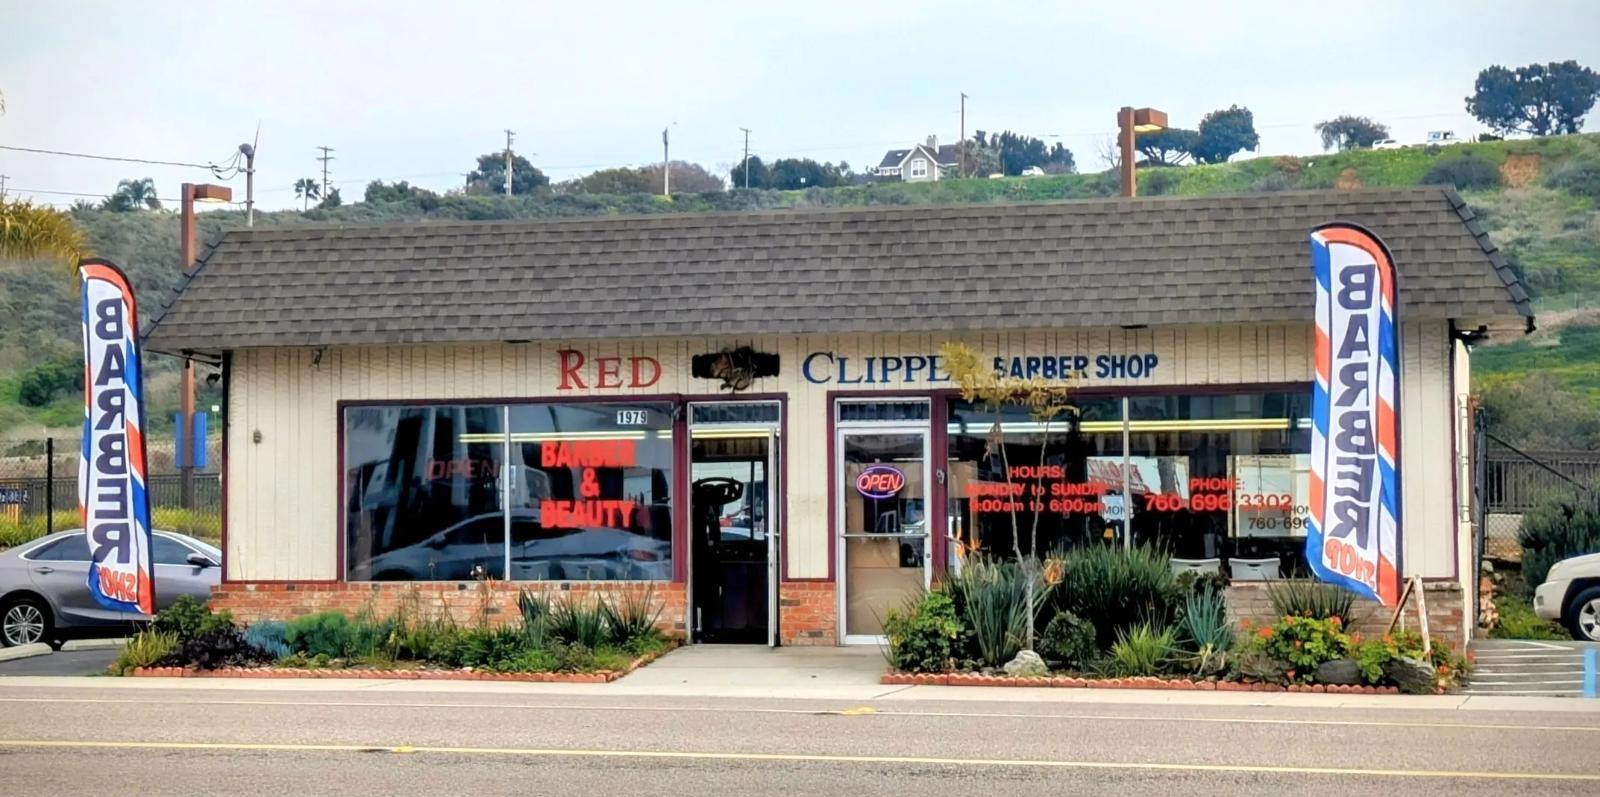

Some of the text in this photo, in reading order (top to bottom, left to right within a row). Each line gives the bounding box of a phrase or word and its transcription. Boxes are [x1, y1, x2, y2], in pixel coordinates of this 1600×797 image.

[557, 349, 953, 390] RED CLIPPE
[993, 353, 1159, 380] BARBER SHOP
[619, 411, 647, 424] 1979
[427, 459, 499, 480] OPEN
[1008, 465, 1066, 479] HOURS:
[580, 468, 600, 497] &
[860, 474, 900, 490] OPEN
[1031, 484, 1046, 496] to
[1190, 477, 1246, 491] PHONE:
[540, 500, 635, 528] BEAUTY
[1030, 500, 1045, 512] to
